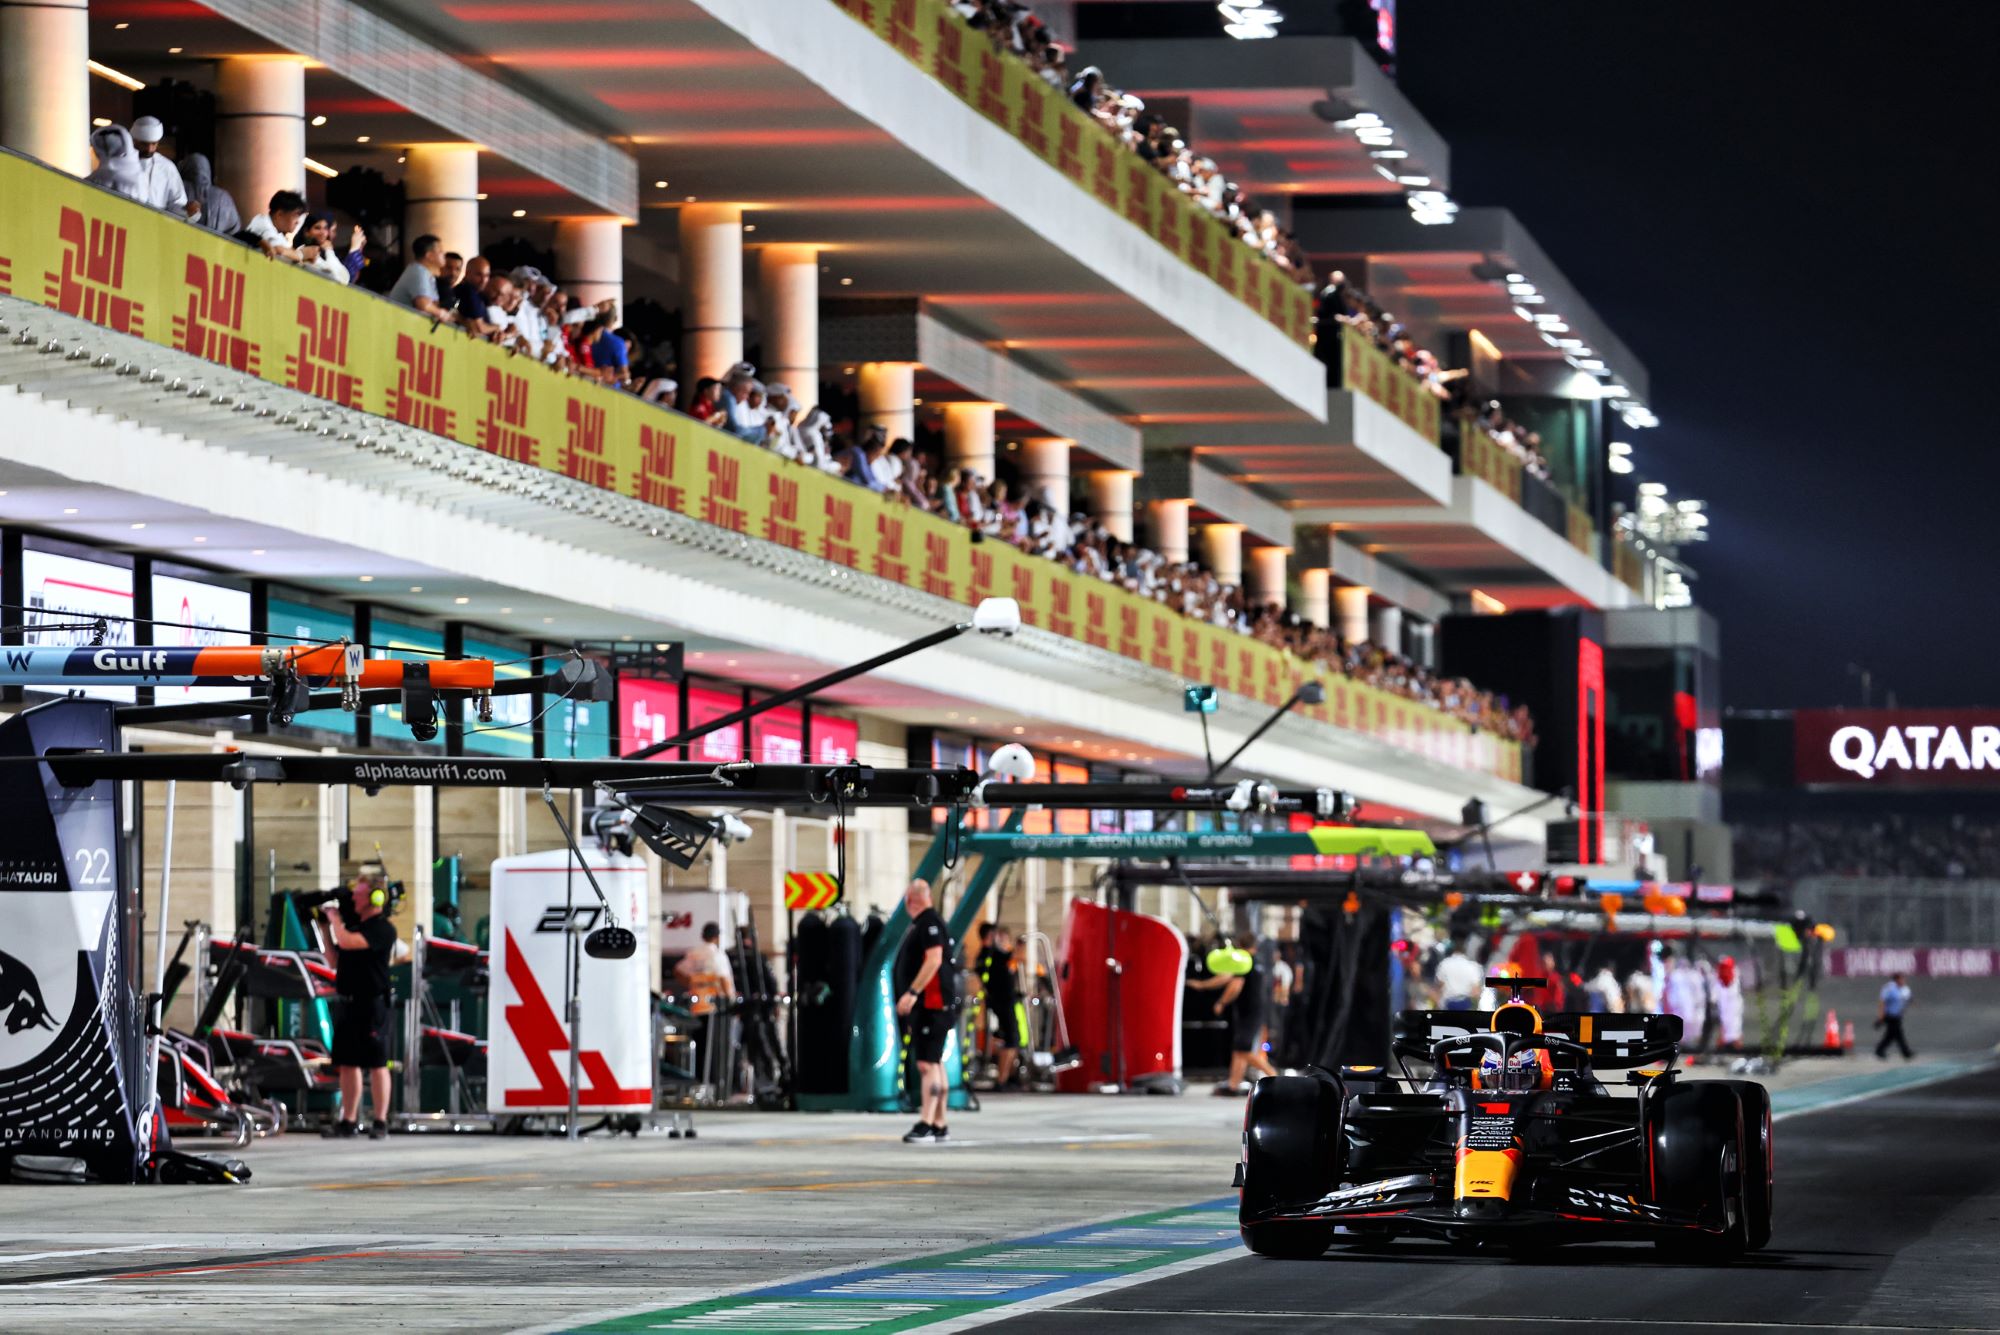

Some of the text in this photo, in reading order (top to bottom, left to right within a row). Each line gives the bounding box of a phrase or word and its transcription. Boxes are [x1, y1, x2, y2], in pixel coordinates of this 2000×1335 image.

[51, 207, 139, 337] DHL
[177, 254, 256, 376] DHL
[291, 297, 359, 410] DHL
[93, 649, 167, 671] Gulf
[349, 650, 361, 667] W
[1829, 725, 2000, 779] QATAR
[355, 763, 506, 781] alphataurif1.com
[0, 871, 58, 884] HATAURI
[75, 848, 111, 884] 22
[533, 907, 602, 932] 20
[1477, 1103, 1511, 1114] 1
